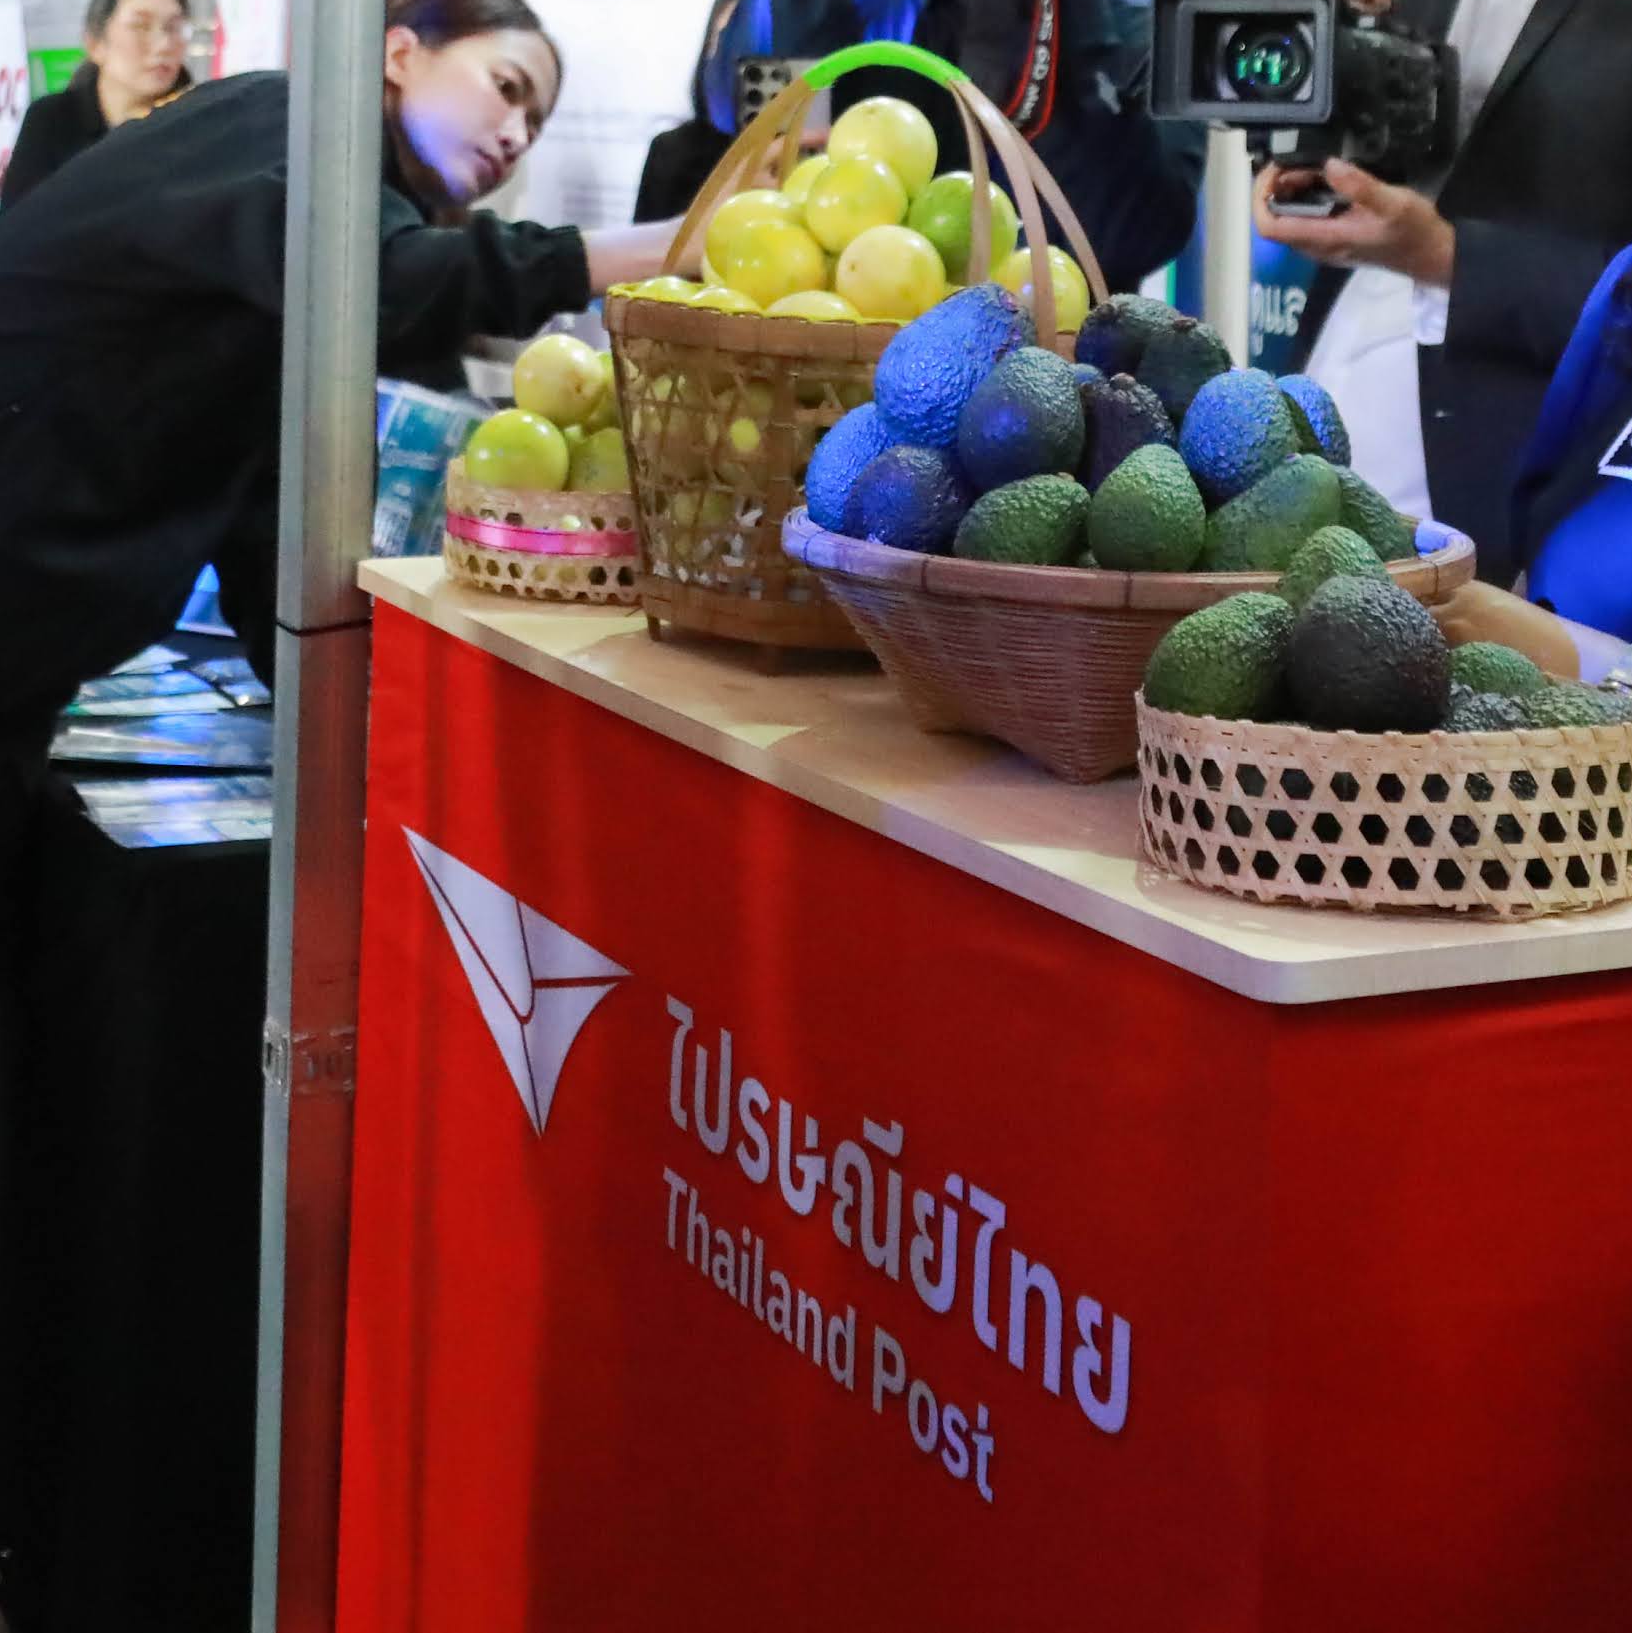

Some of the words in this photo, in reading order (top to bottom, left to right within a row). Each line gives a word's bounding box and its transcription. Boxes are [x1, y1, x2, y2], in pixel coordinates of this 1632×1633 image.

[662, 1165, 855, 1393] Thailand
[873, 1324, 995, 1504] Post
[665, 992, 1132, 1435] ไปรษณีย์ไทย
